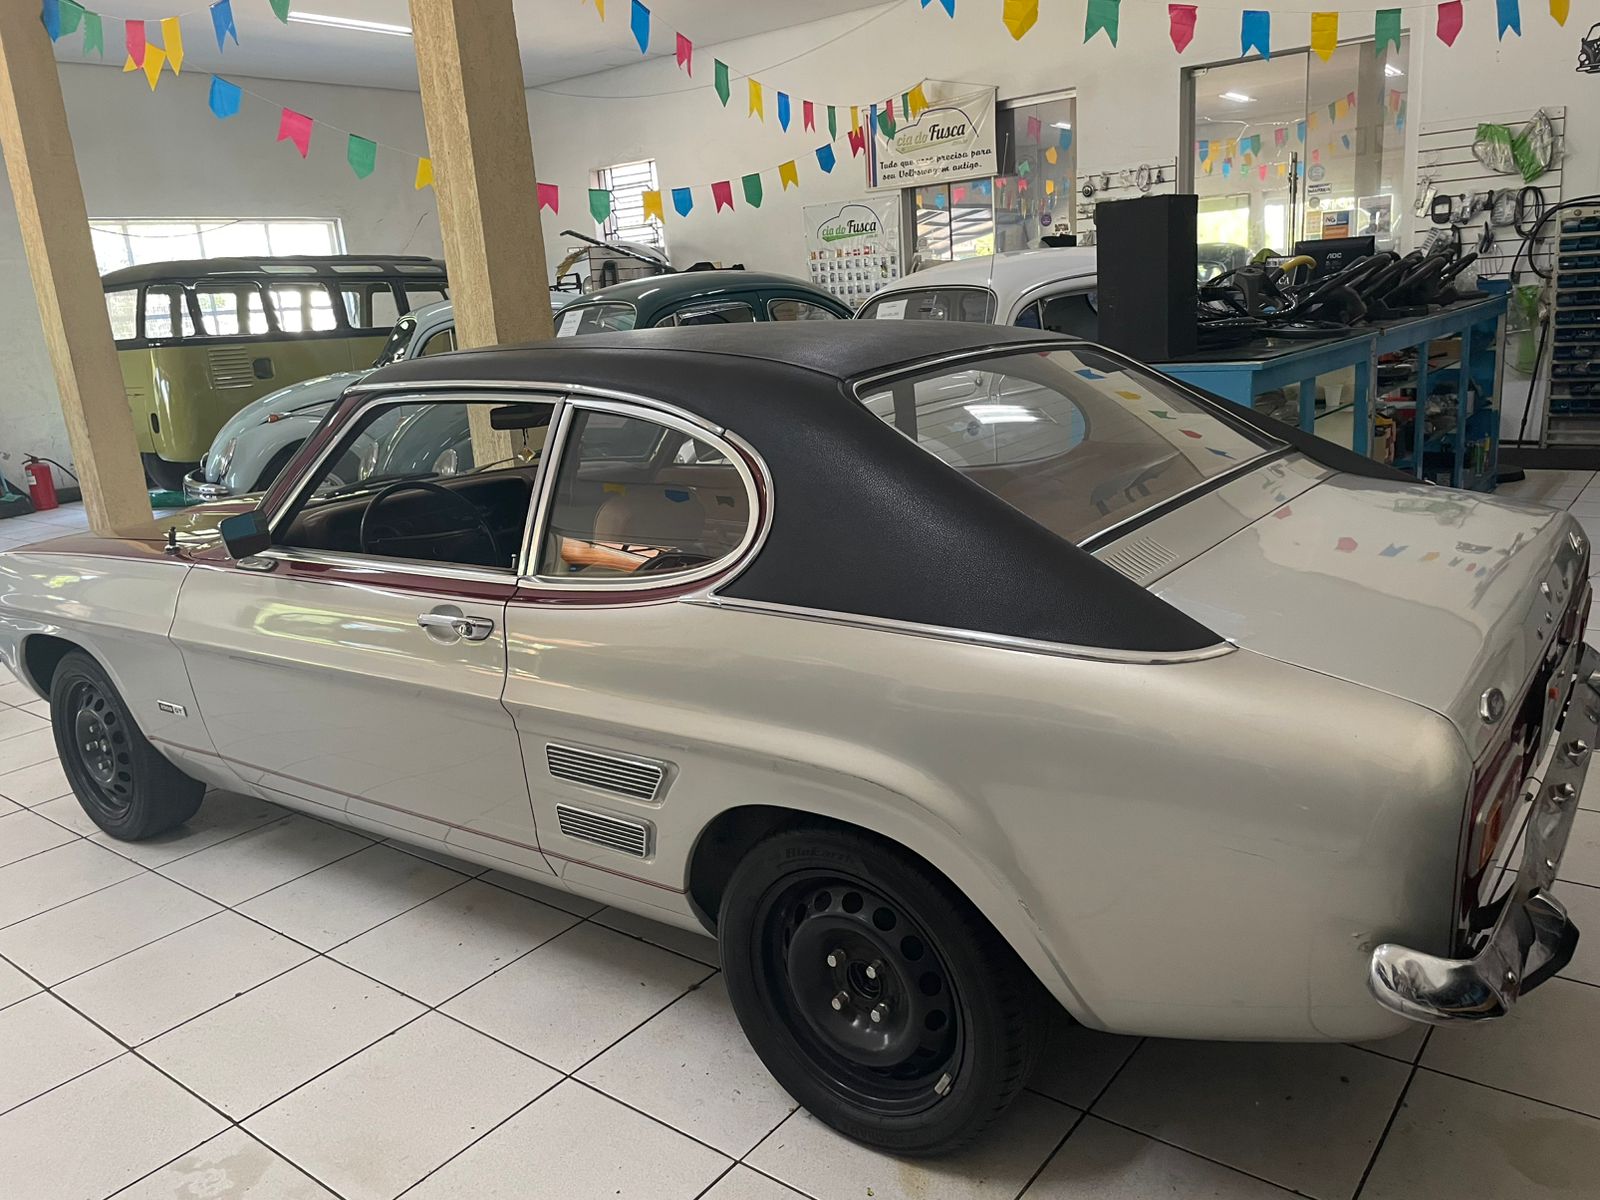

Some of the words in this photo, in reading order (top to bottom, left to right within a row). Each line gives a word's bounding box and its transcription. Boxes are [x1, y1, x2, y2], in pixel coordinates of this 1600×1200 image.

[896, 134, 913, 147] cia
[915, 132, 928, 145] do
[929, 123, 966, 141] Fusca
[880, 161, 898, 170] Tudo
[936, 151, 968, 164] precisa
[971, 148, 992, 158] para
[822, 225, 834, 236] cia
[835, 224, 846, 235] do
[846, 219, 877, 234] Fusca
